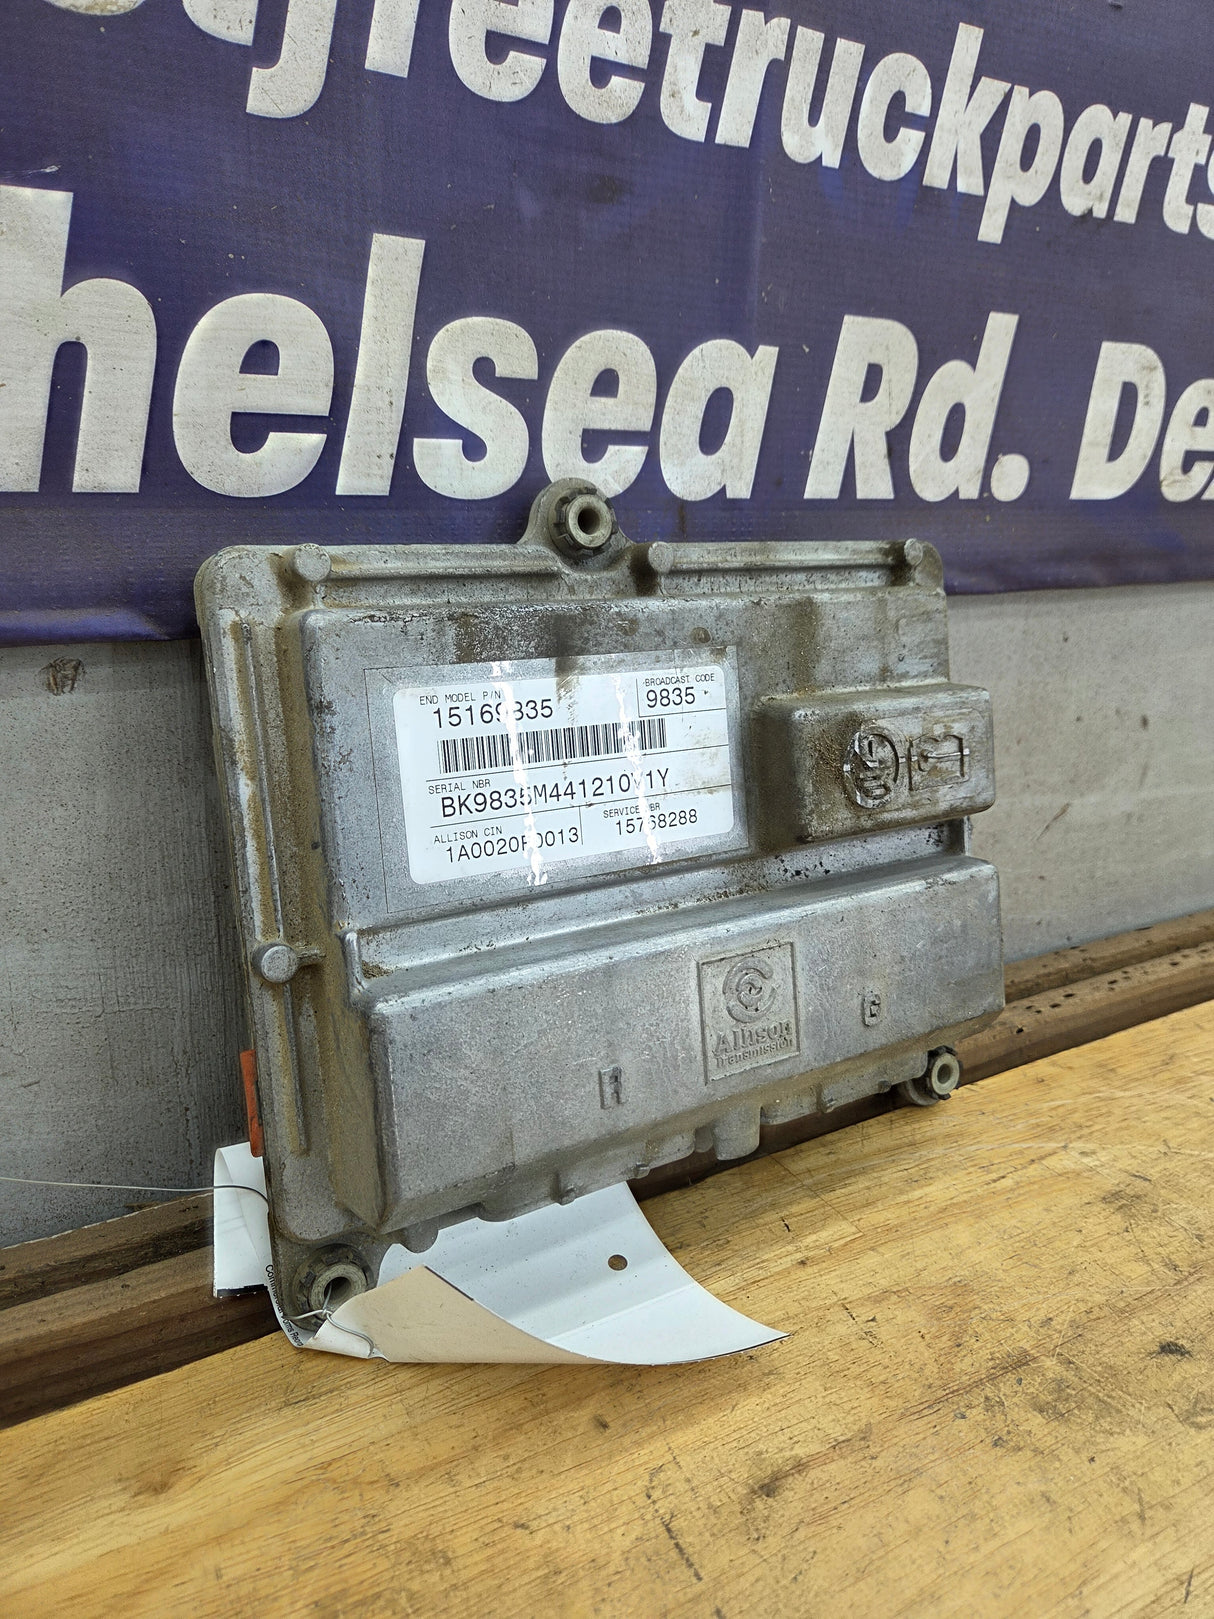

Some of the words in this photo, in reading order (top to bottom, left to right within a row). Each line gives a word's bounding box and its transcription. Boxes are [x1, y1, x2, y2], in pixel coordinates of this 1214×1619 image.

[803, 311, 1030, 502] Rd.
[1069, 340, 1214, 502] De
[644, 674, 690, 687] BROADCAST
[695, 672, 716, 682] CODE
[419, 694, 439, 706] END
[444, 692, 477, 703] MODEL
[482, 690, 501, 701] P/N
[646, 686, 696, 708] 9835
[428, 781, 466, 795] SERIAL
[472, 779, 491, 790] NBR
[602, 805, 640, 819] SERVICE
[644, 802, 661, 812] BR
[433, 829, 478, 845] ALLISON
[483, 826, 503, 837] CIN
[712, 1020, 793, 1057] Allison
[715, 1037, 793, 1068] Transmission
